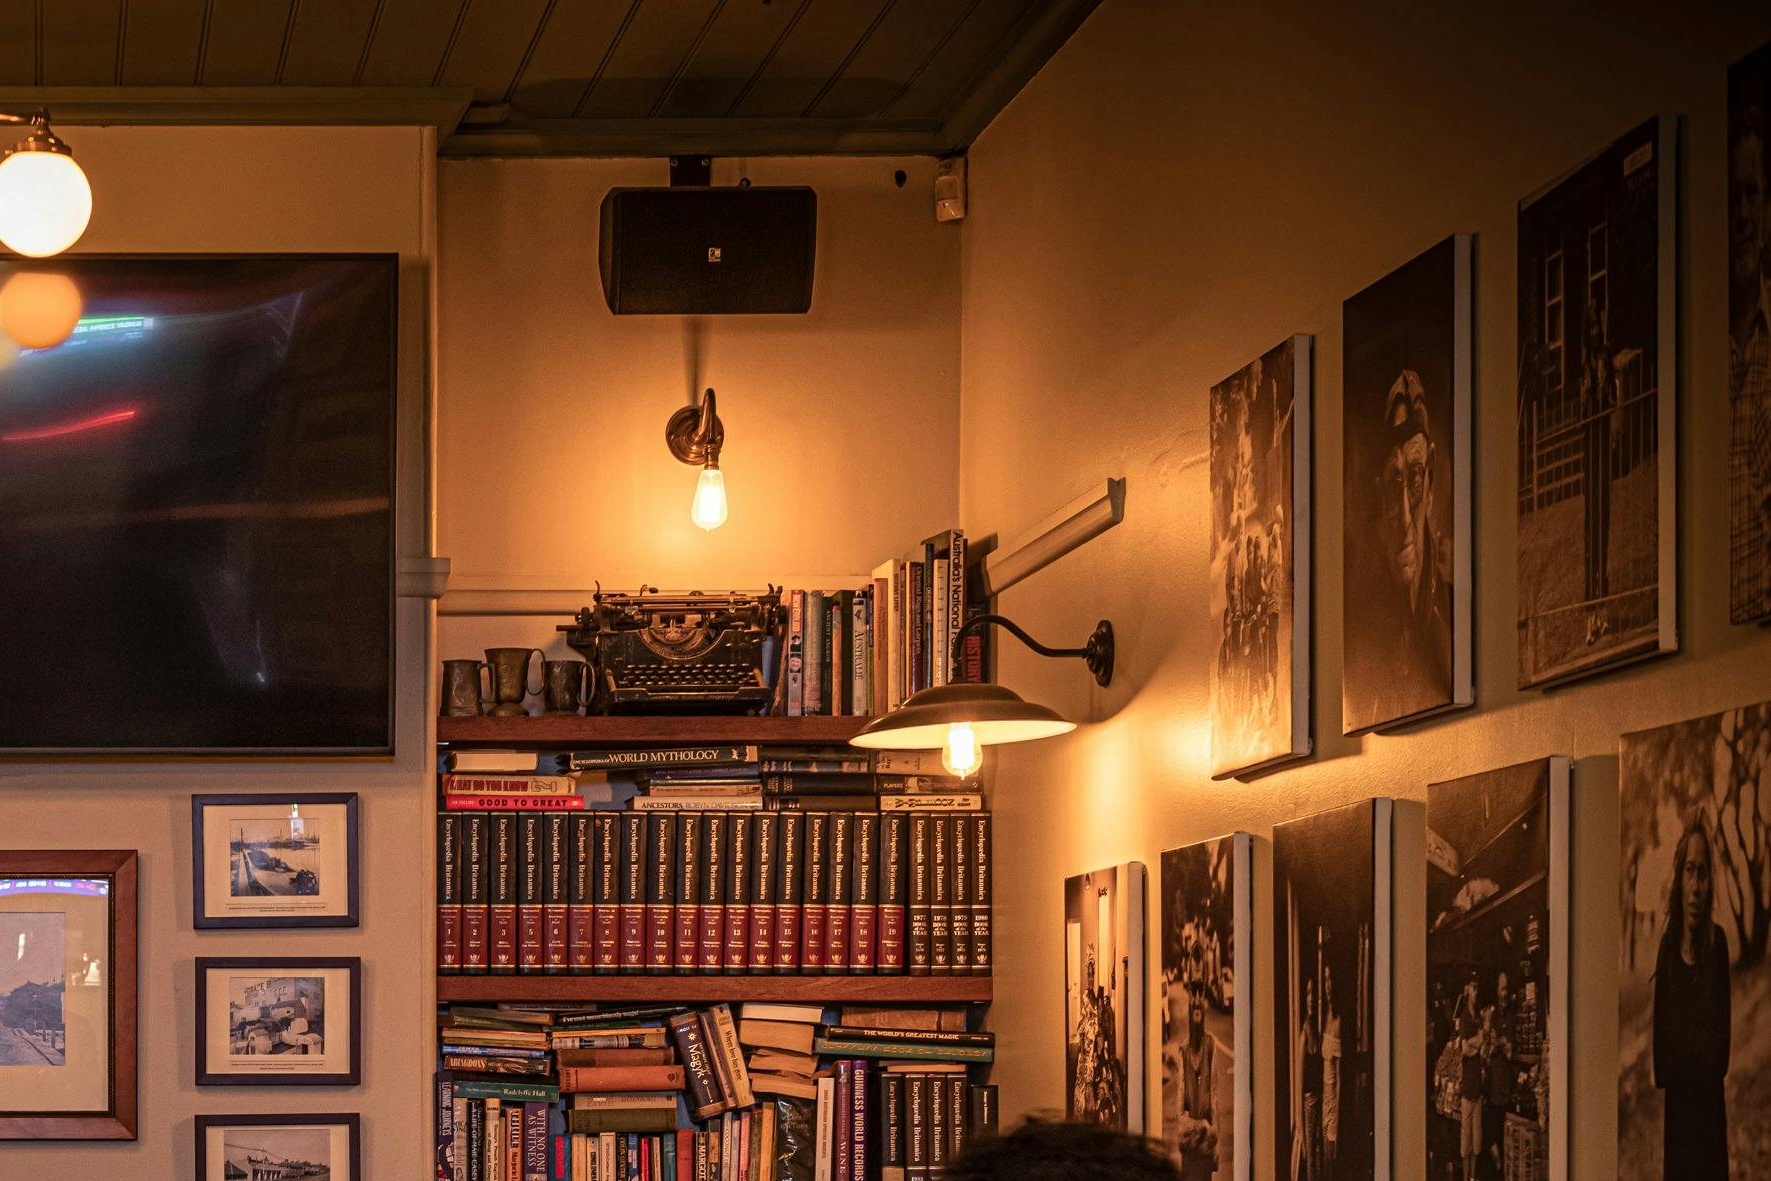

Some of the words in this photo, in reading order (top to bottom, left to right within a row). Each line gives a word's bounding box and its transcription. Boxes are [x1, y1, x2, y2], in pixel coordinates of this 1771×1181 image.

[952, 532, 962, 583] Australia's
[951, 585, 960, 630] National
[854, 630, 864, 680] AUSTRALIE
[609, 752, 648, 764] WORLD
[650, 750, 718, 762] MYTHOLOGY
[478, 799, 507, 807] GOOD
[514, 799, 528, 807] TO
[532, 799, 567, 807] GREAT
[630, 865, 638, 899] Britannica
[735, 865, 743, 899] Britannica
[812, 865, 820, 899] Britannica
[836, 865, 844, 899] Britannica
[890, 865, 898, 899] Britannica
[978, 866, 986, 900] Britannica
[688, 1043, 704, 1078] Magyk
[442, 1081, 451, 1107] LEARNING
[503, 1088, 531, 1096] Radclyffe
[854, 1069, 864, 1111] GUINNESS
[442, 1109, 451, 1136] JOURNEYS
[527, 1115, 536, 1125] AS
[536, 1109, 546, 1135] WITH
[854, 1112, 864, 1142] WORLD
[527, 1127, 536, 1166] WITNESS
[536, 1136, 546, 1150] NO
[840, 1141, 848, 1174] WINE
[536, 1153, 546, 1172] ONE
[698, 1145, 707, 1179] MARGOT
[854, 1144, 864, 1181] RECORDS
